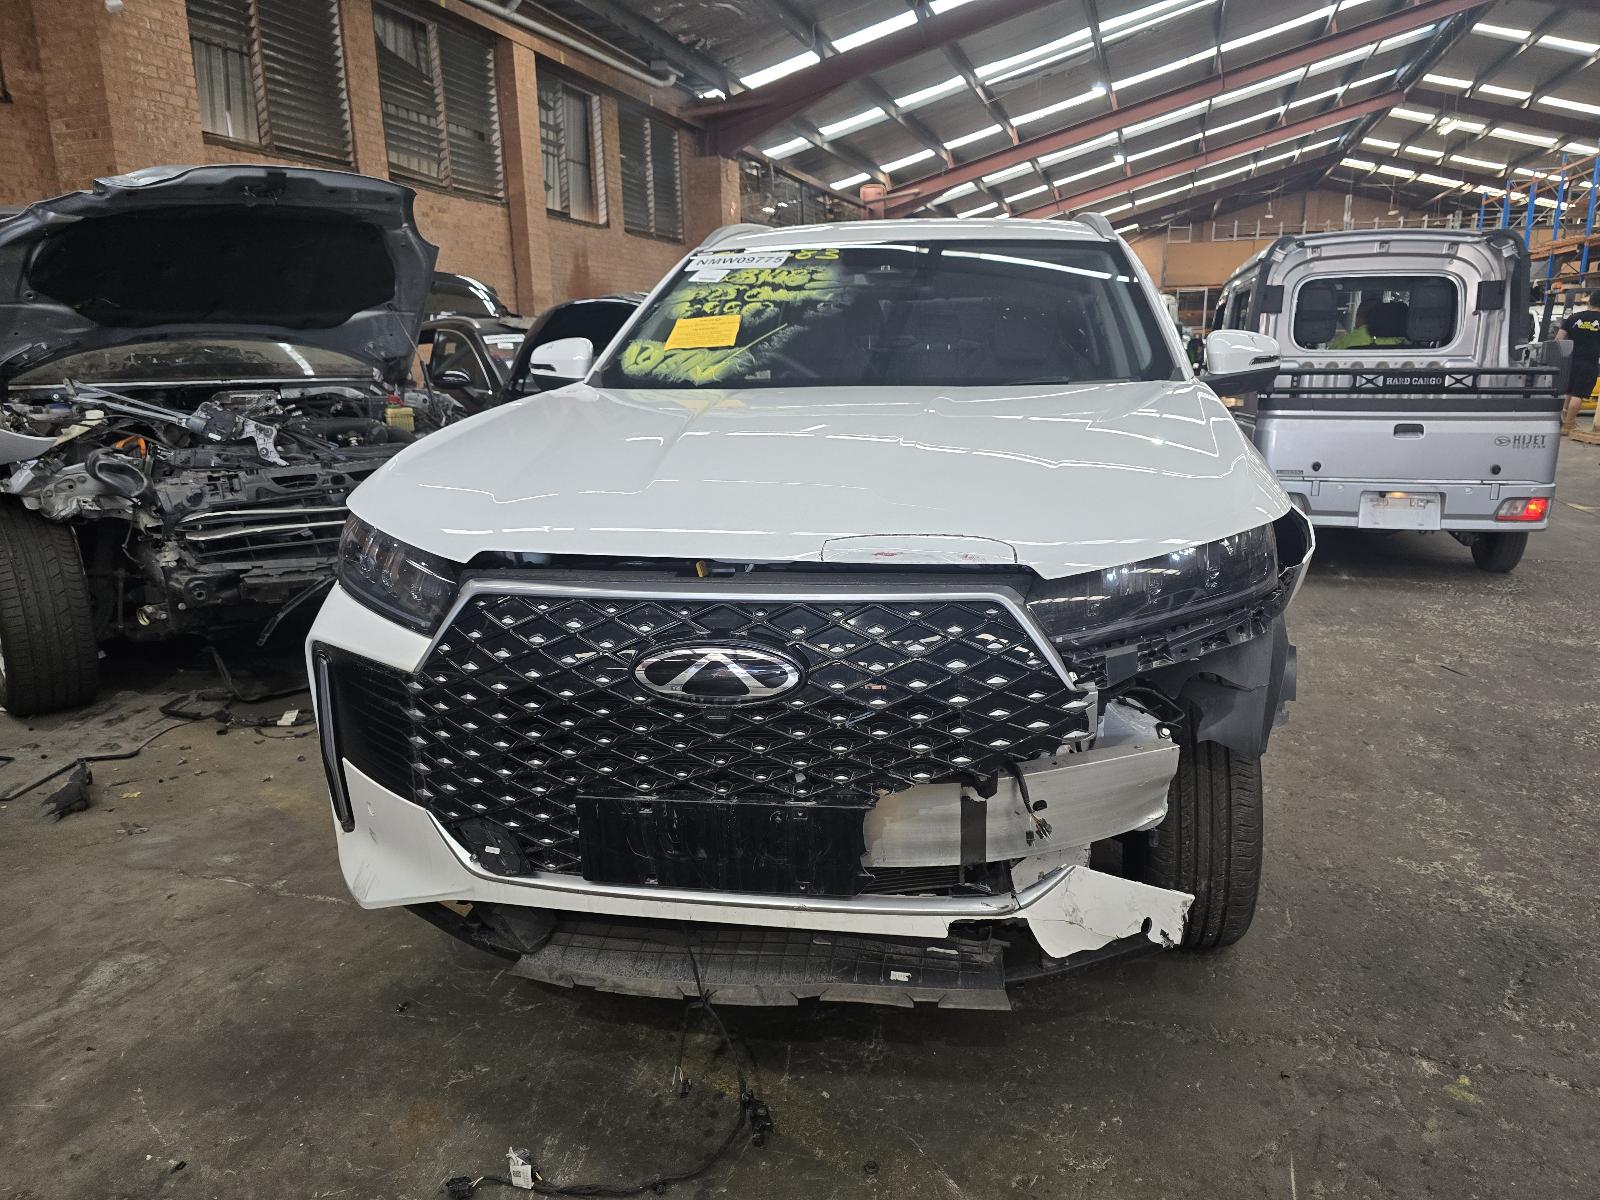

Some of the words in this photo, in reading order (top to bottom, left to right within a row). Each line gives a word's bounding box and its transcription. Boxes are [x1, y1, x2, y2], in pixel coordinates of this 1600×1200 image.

[695, 256, 785, 266] NMW09775
[1386, 377, 1411, 385] HARD
[1412, 377, 1442, 385] CARGO
[1513, 434, 1547, 445] HIJET
